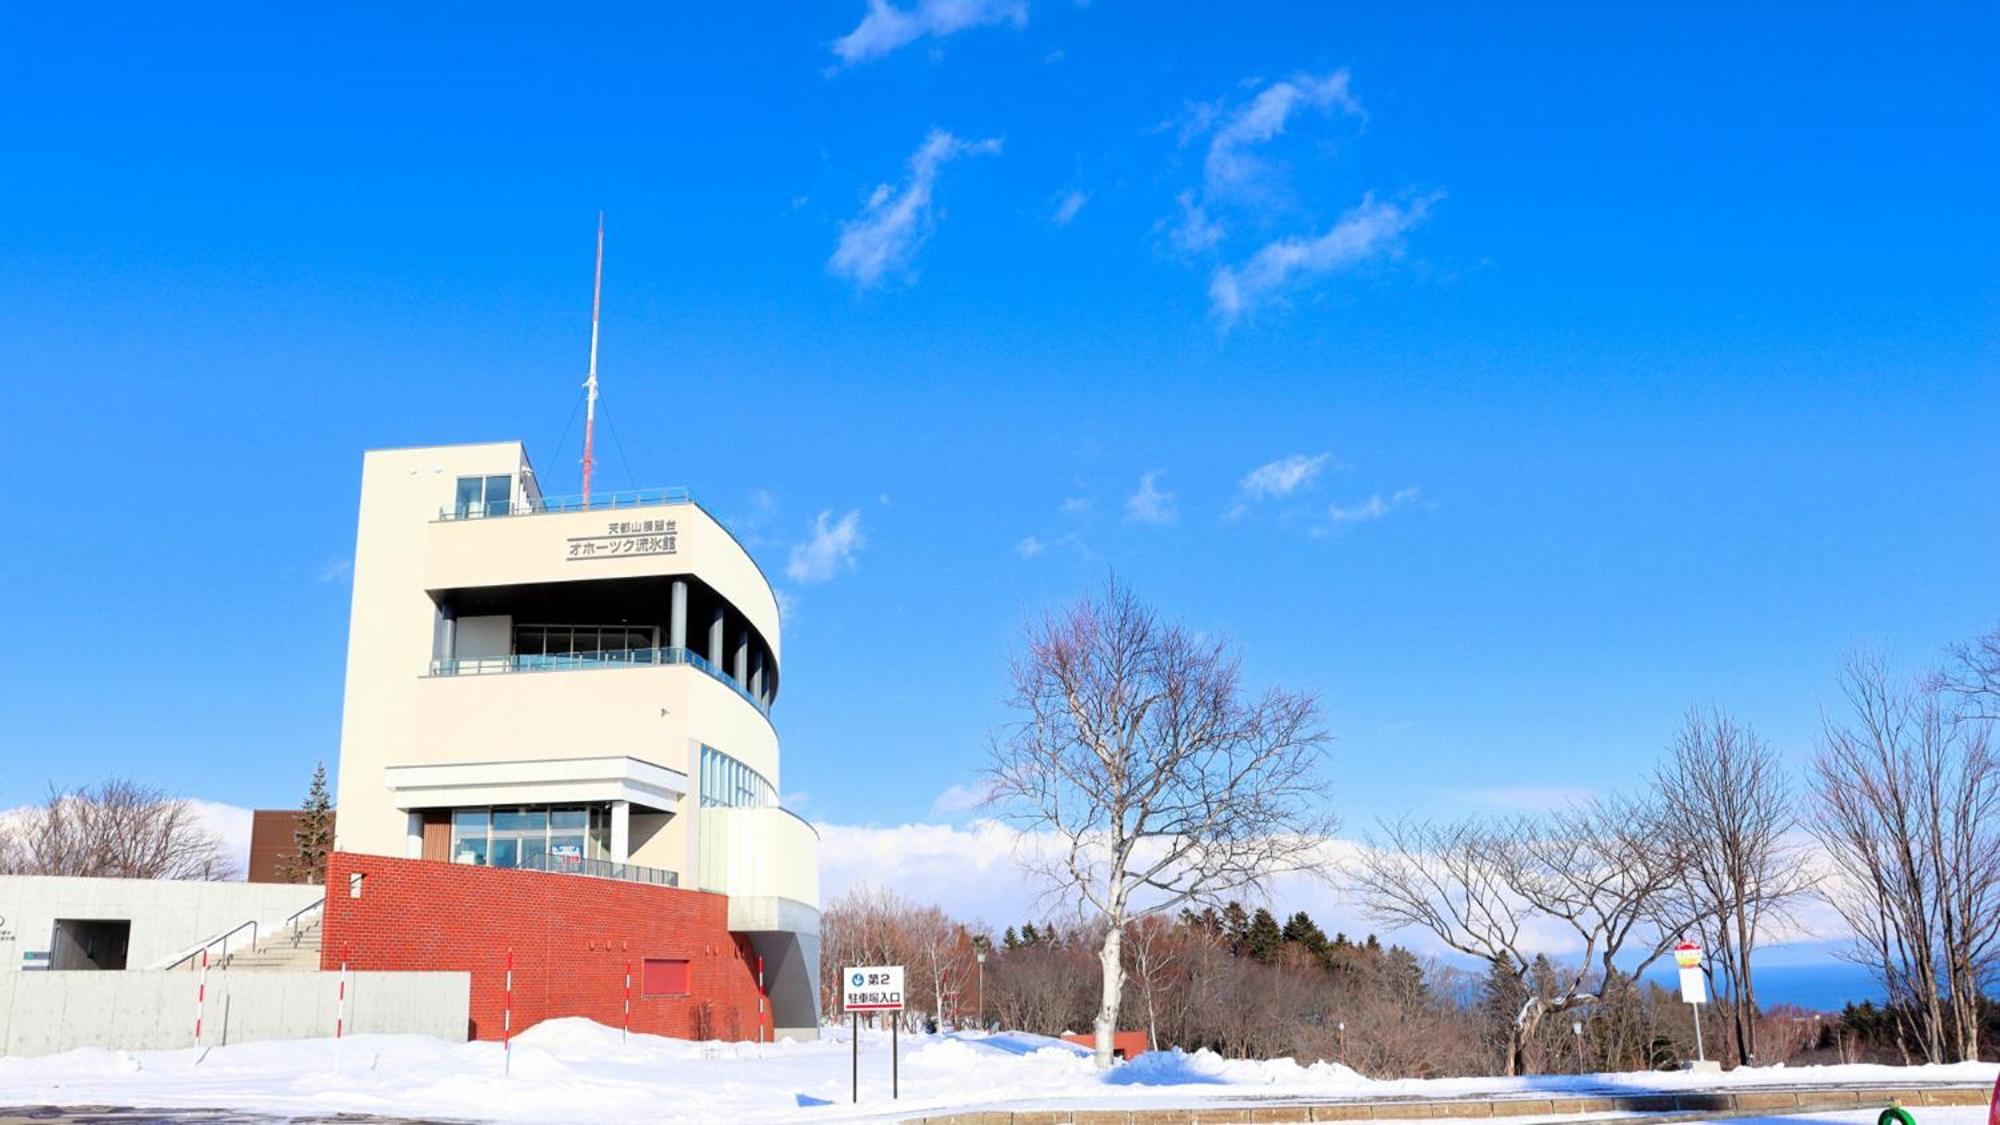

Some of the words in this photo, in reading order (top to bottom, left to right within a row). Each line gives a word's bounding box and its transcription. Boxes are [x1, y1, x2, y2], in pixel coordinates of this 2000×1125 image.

[570, 536, 676, 556] オホーツク流氷館
[868, 973, 890, 985] 第2
[848, 992, 900, 1003] 駐車場入口
